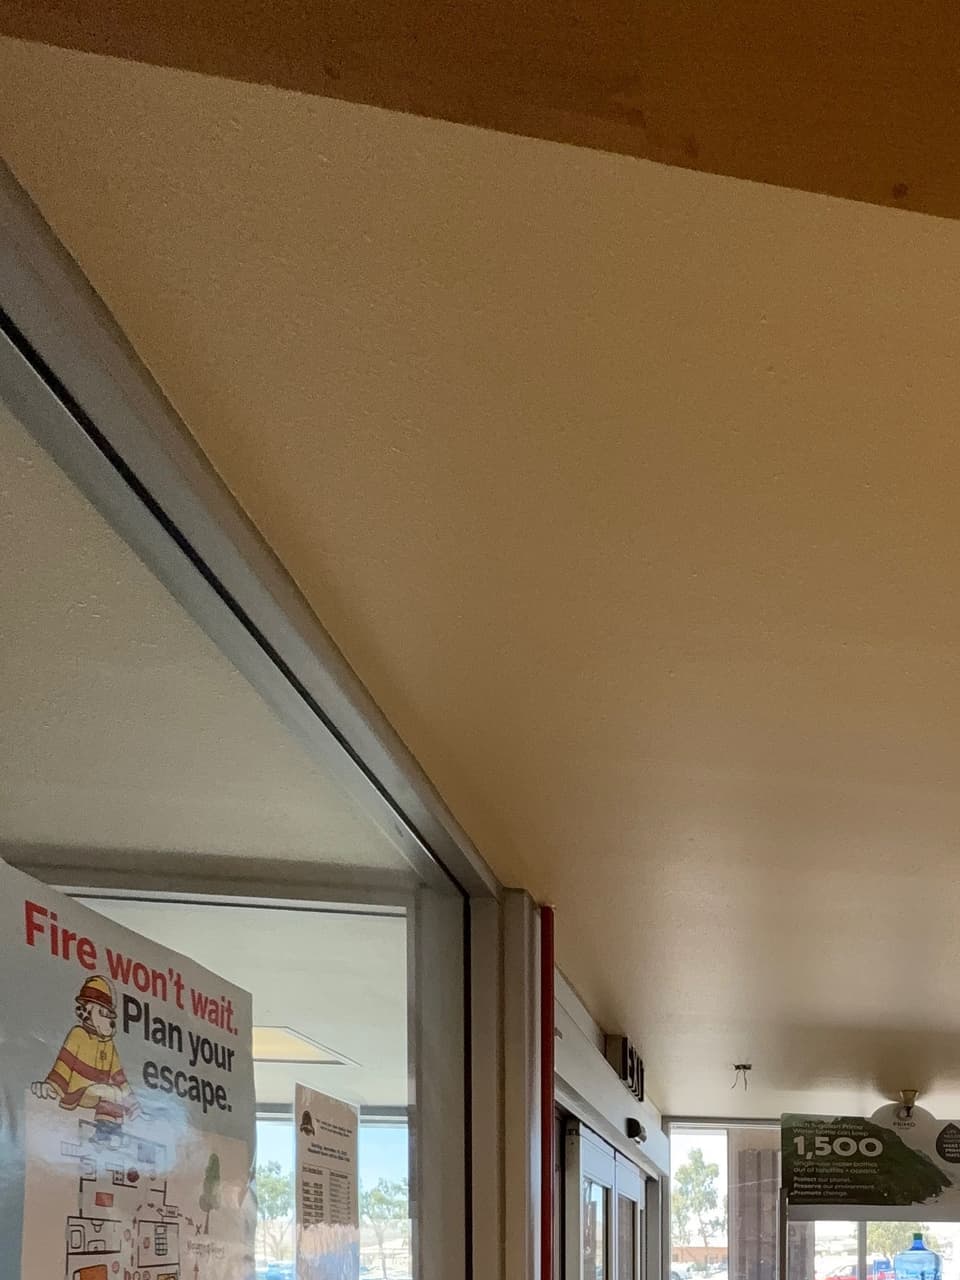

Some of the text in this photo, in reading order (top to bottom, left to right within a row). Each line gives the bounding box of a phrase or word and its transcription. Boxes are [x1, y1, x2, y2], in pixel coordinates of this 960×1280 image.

[24, 900, 238, 1036] Fire won't wait.
[122, 993, 235, 1072] Plan your
[143, 1060, 232, 1113] escape.
[793, 1136, 883, 1160] 1,500
